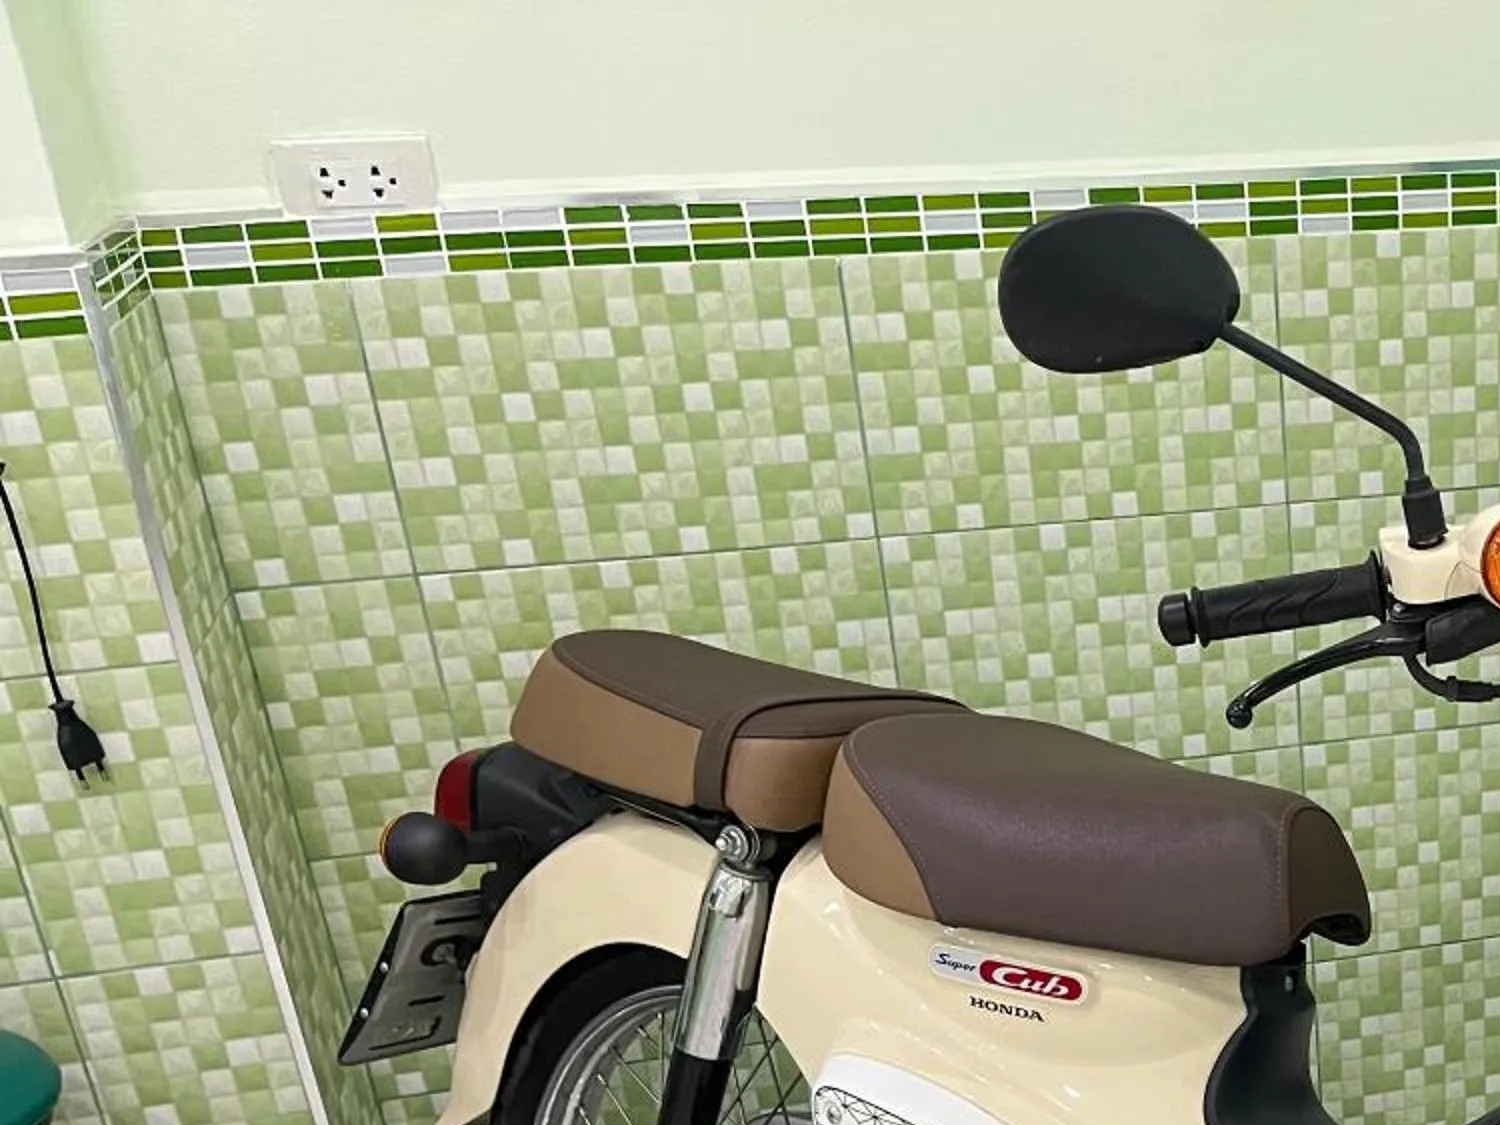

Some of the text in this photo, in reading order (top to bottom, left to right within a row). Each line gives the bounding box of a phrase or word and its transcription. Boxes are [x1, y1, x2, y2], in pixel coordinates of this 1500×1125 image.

[934, 953, 1069, 996] Super Cub
[969, 995, 1045, 1023] HONDA
